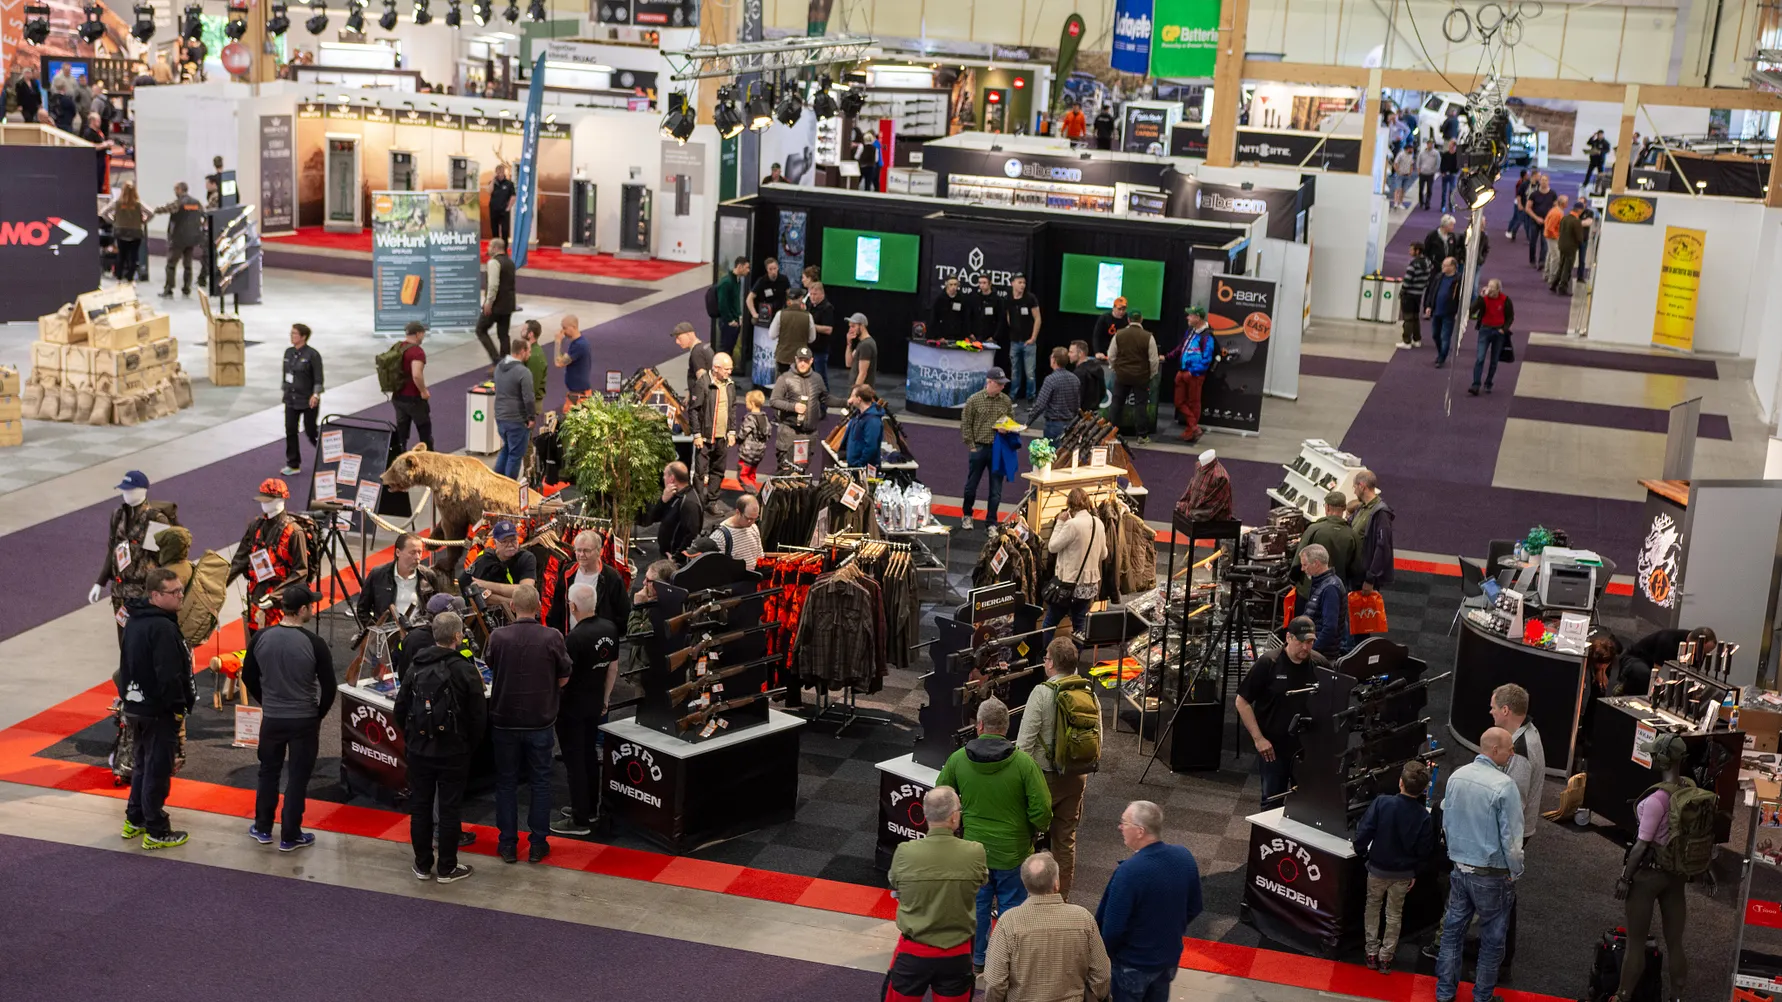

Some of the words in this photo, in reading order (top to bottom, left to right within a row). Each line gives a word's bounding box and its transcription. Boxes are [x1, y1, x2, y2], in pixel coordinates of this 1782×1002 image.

[1161, 25, 1181, 42] GP
[0, 221, 50, 246] MO
[376, 233, 426, 248] WeHunt
[429, 231, 477, 245] WeHunt
[935, 265, 1012, 287] TRACER
[919, 365, 970, 383] TRACKER
[595, 637, 614, 651] ASTRO
[350, 705, 397, 742] ASTRO
[351, 741, 397, 768] SWEDEN
[611, 743, 662, 782] ASTRO
[609, 779, 661, 808] SWEDEN
[890, 784, 928, 807] AST
[1260, 838, 1321, 881] ASTRO
[1255, 875, 1318, 910] SWEDEN
